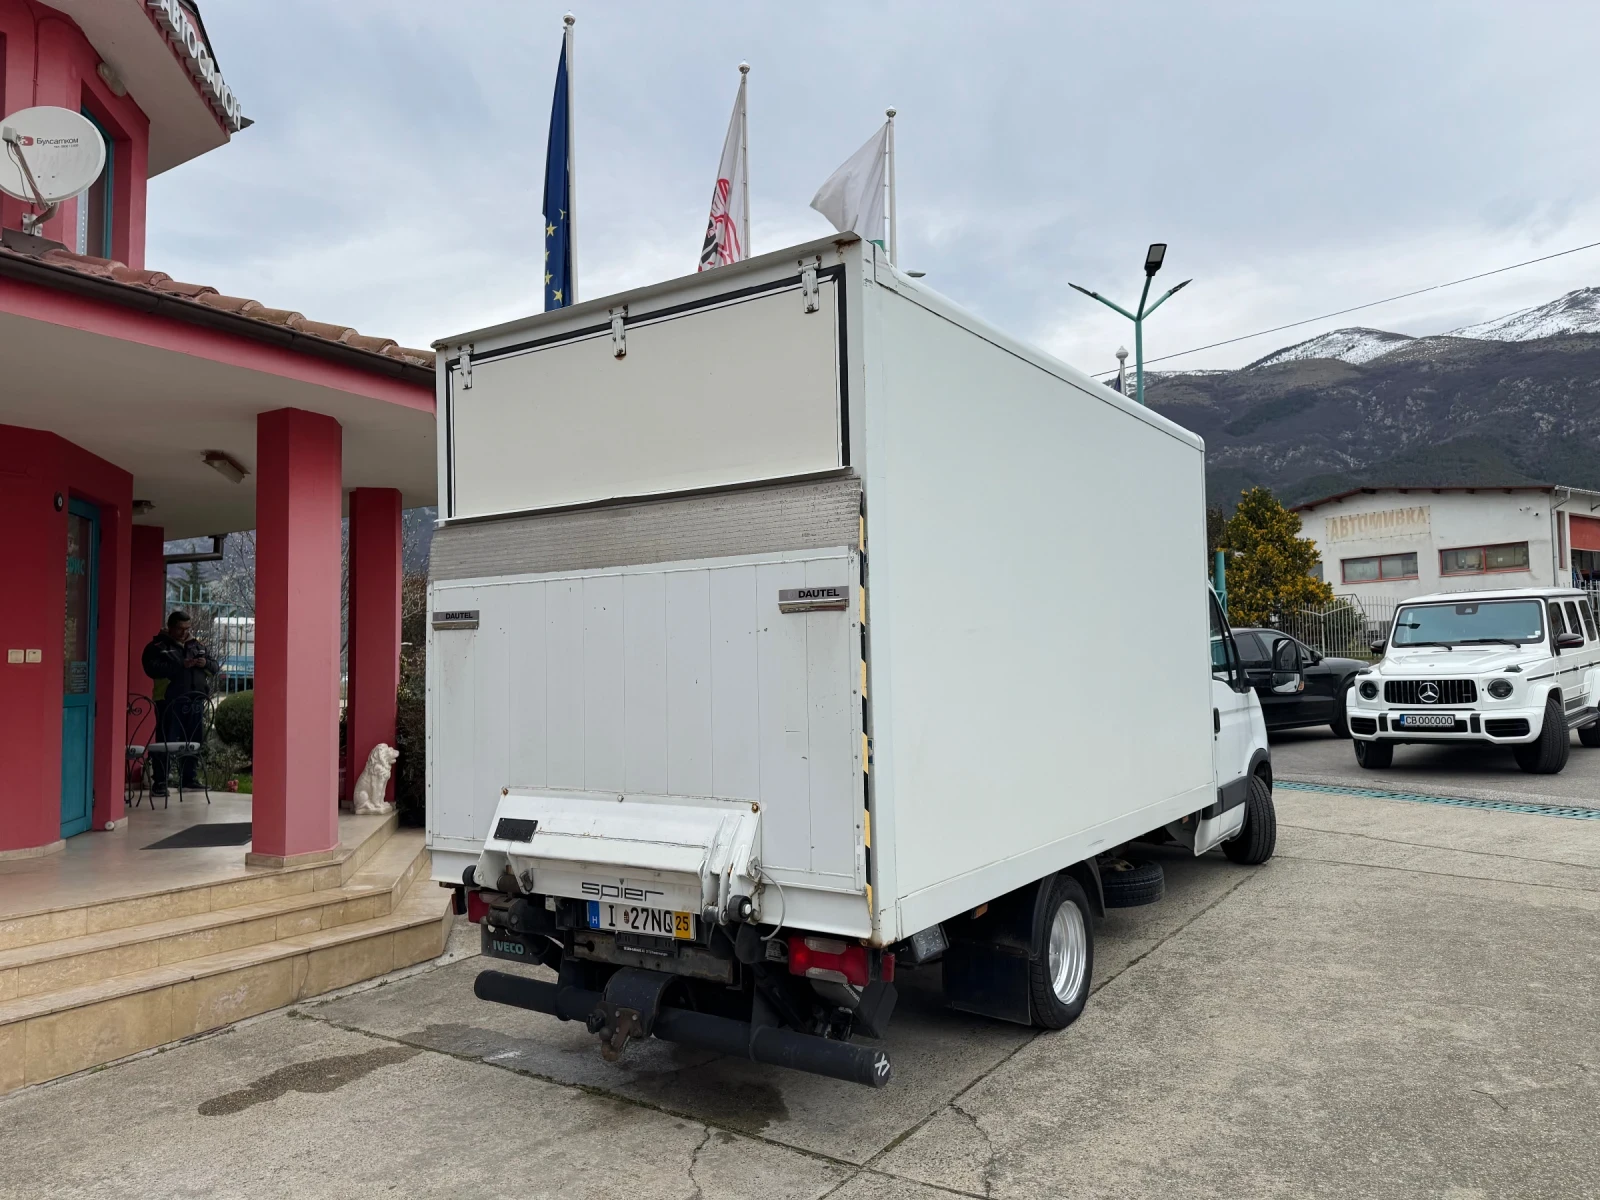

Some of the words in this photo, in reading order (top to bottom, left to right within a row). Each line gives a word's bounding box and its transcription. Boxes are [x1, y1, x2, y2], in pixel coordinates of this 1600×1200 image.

[1331, 508, 1427, 541] АВТОМИВКА
[798, 589, 840, 598] DAUTEL
[445, 612, 473, 620] DAUTEL
[581, 879, 664, 902] spier
[675, 915, 689, 932] 25
[492, 940, 524, 955] IVECO
